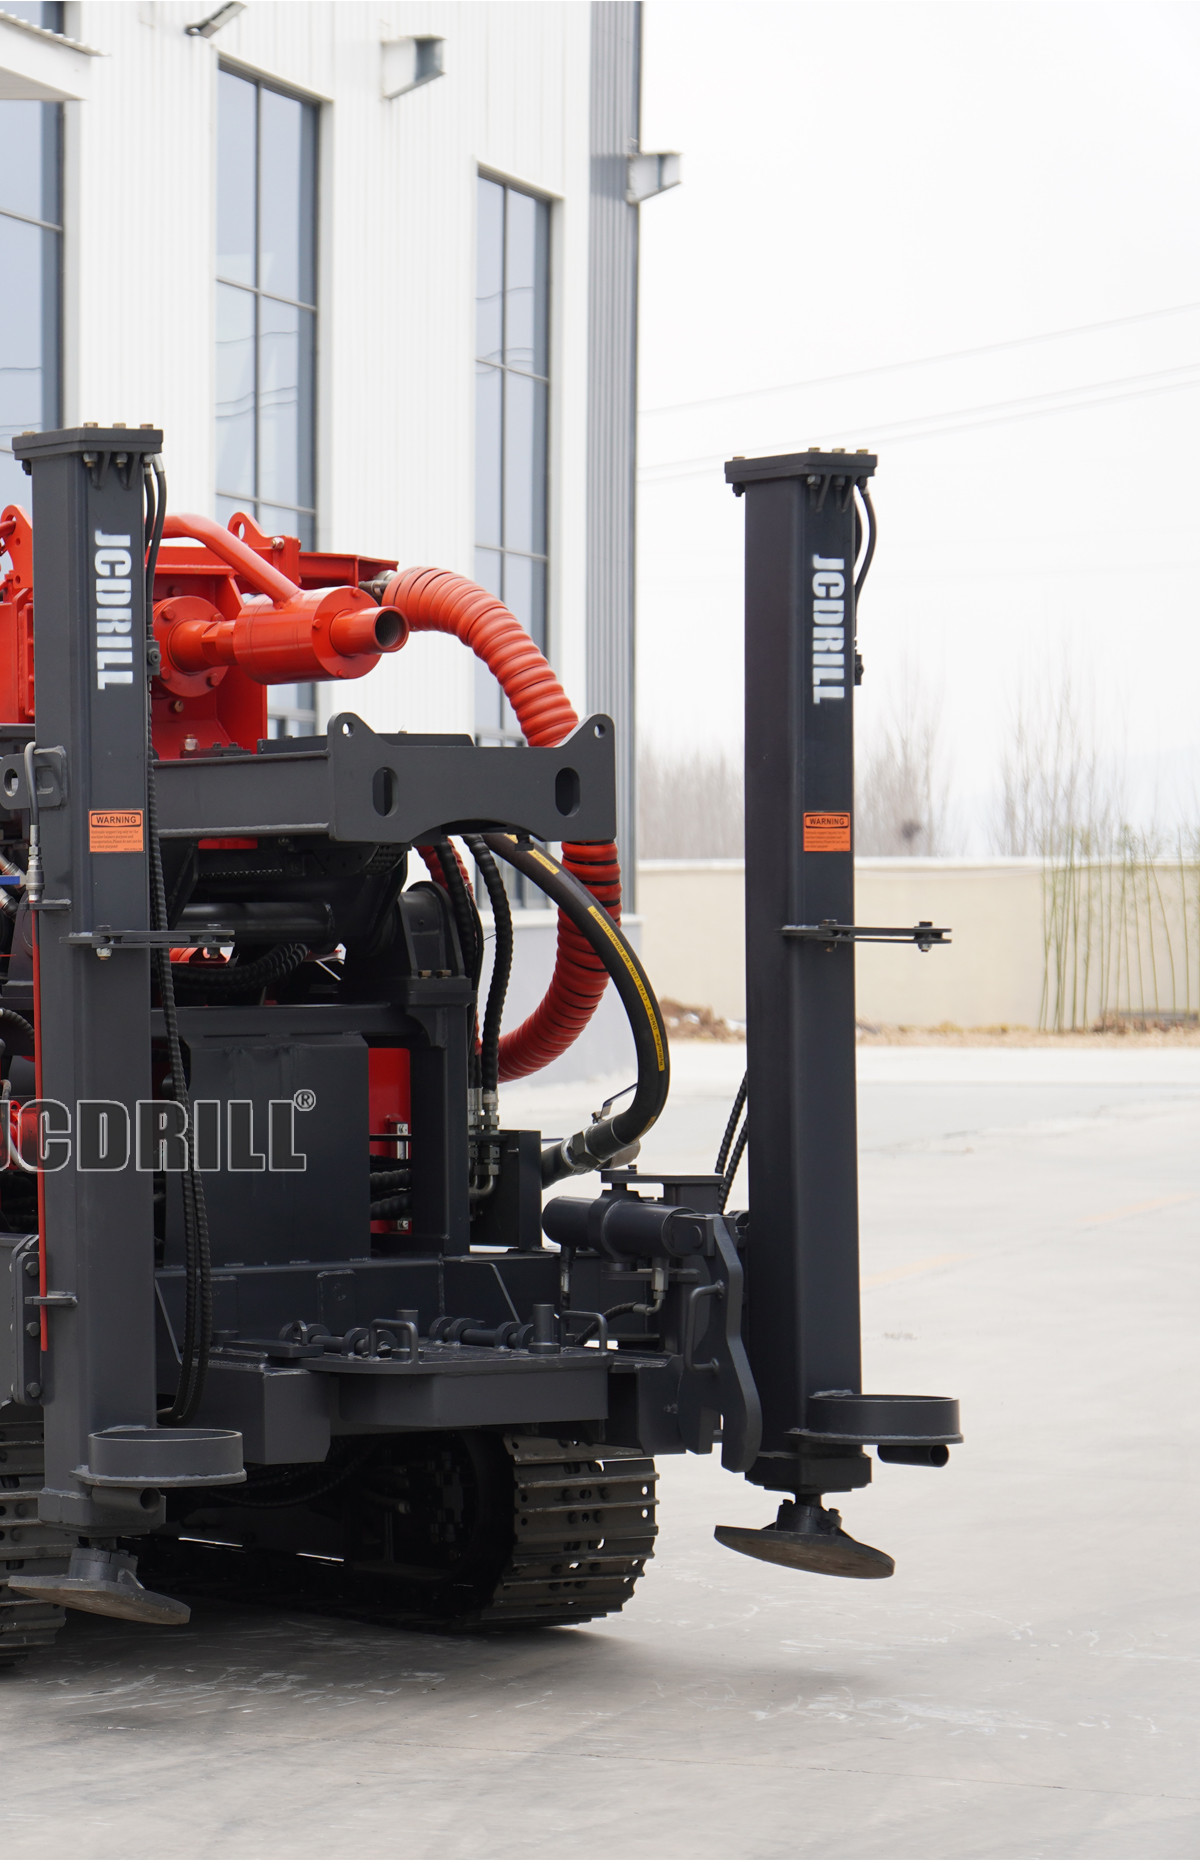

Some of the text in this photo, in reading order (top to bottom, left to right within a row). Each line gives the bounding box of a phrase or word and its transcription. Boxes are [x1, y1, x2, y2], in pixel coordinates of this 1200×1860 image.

[94, 528, 133, 690] JCDRILL
[812, 553, 845, 704] JCDRILL
[96, 816, 137, 824] WARNING
[809, 817, 845, 825] WARNING
